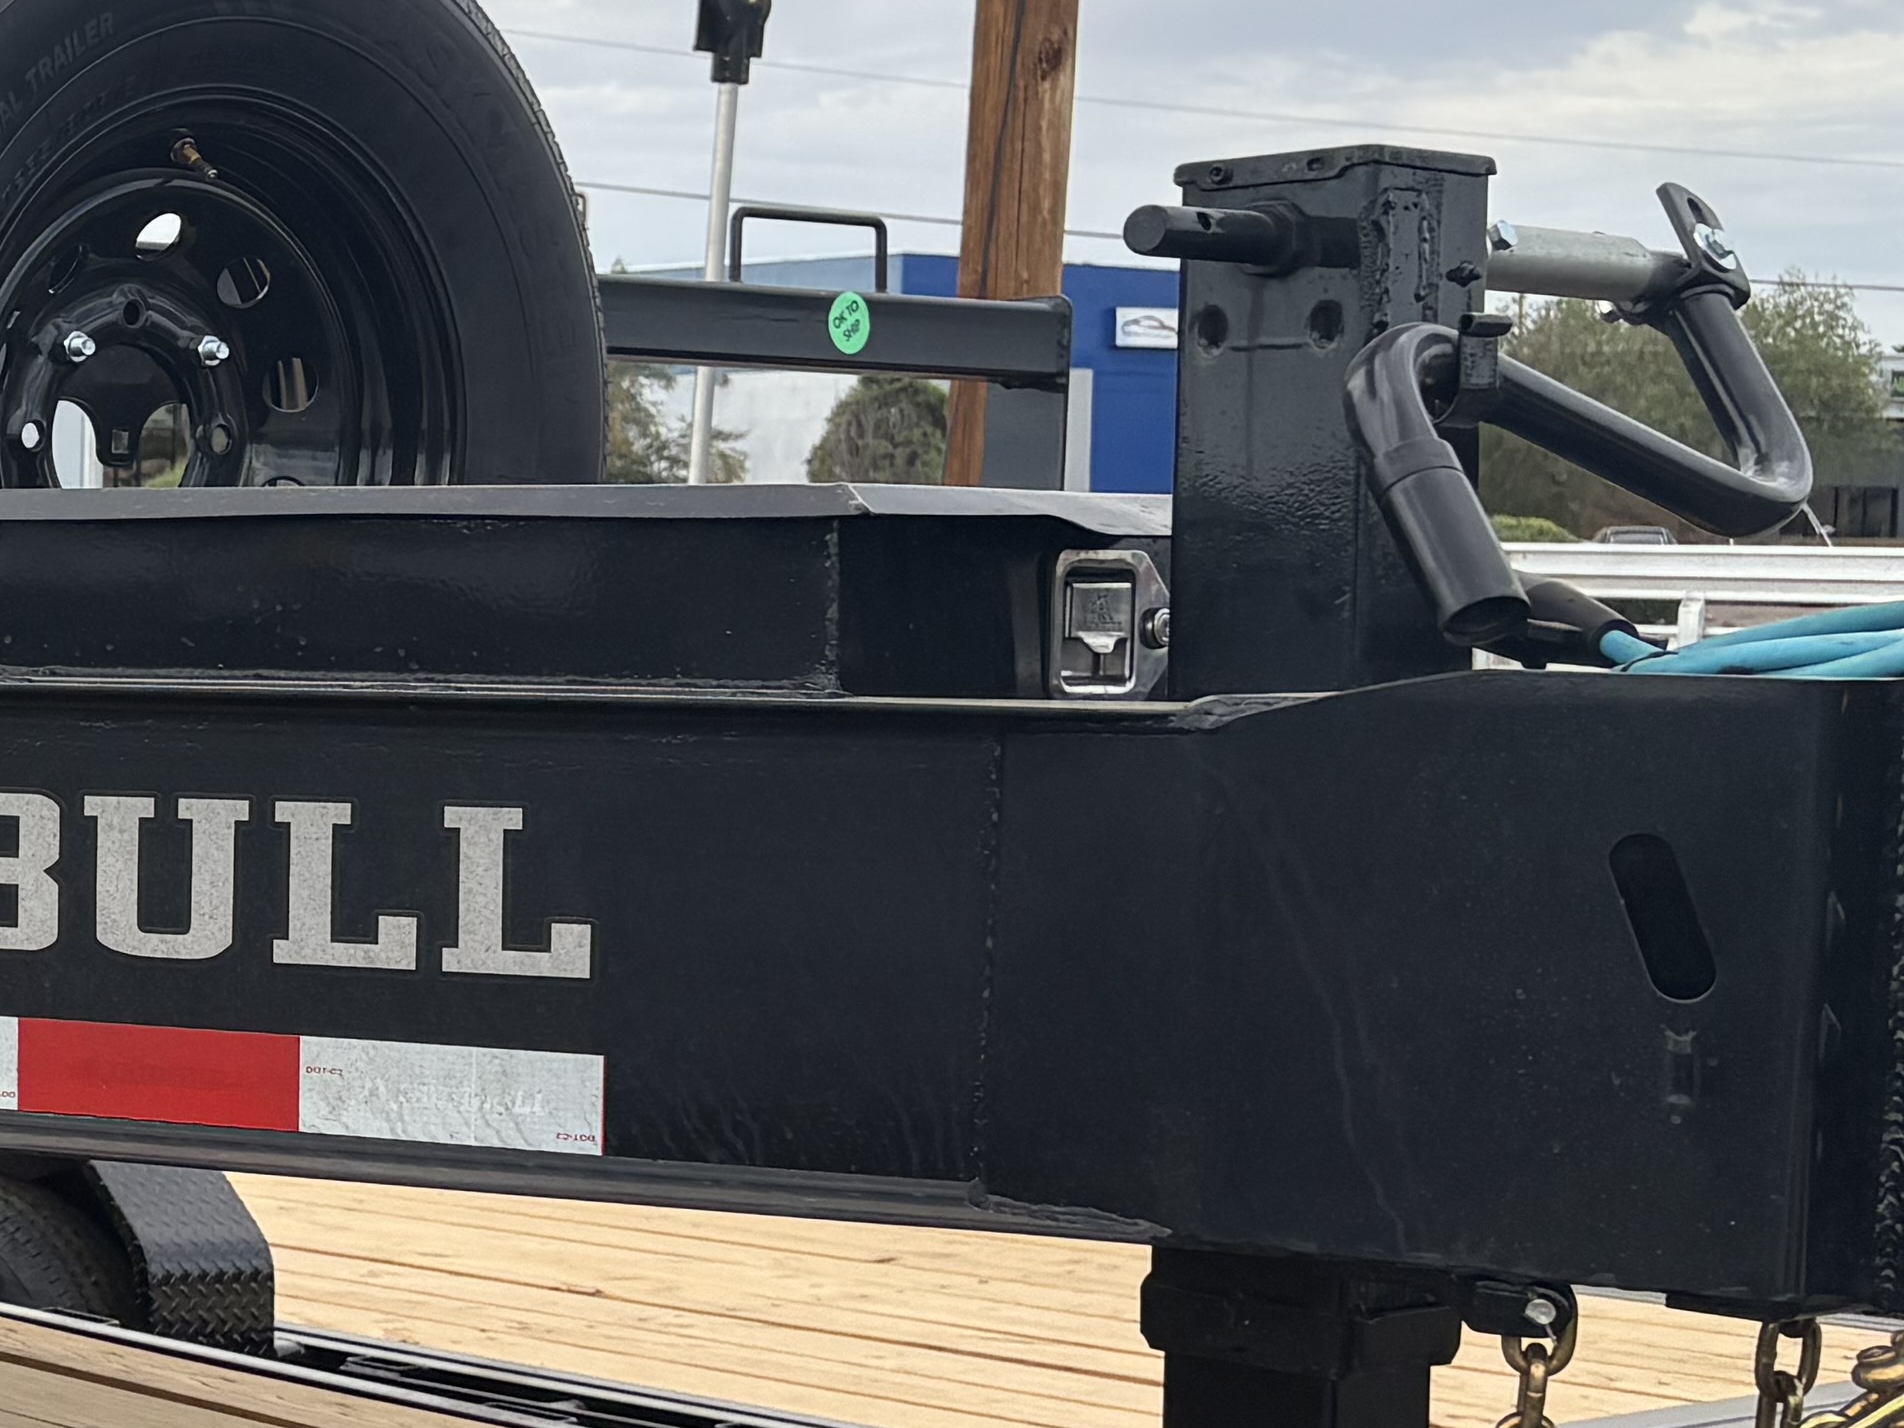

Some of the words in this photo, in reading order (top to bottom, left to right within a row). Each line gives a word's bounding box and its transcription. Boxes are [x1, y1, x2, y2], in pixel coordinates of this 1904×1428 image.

[24, 12, 115, 95] TRAILER
[845, 300, 860, 316] TO
[555, 1132, 596, 1143] DOT-C2
